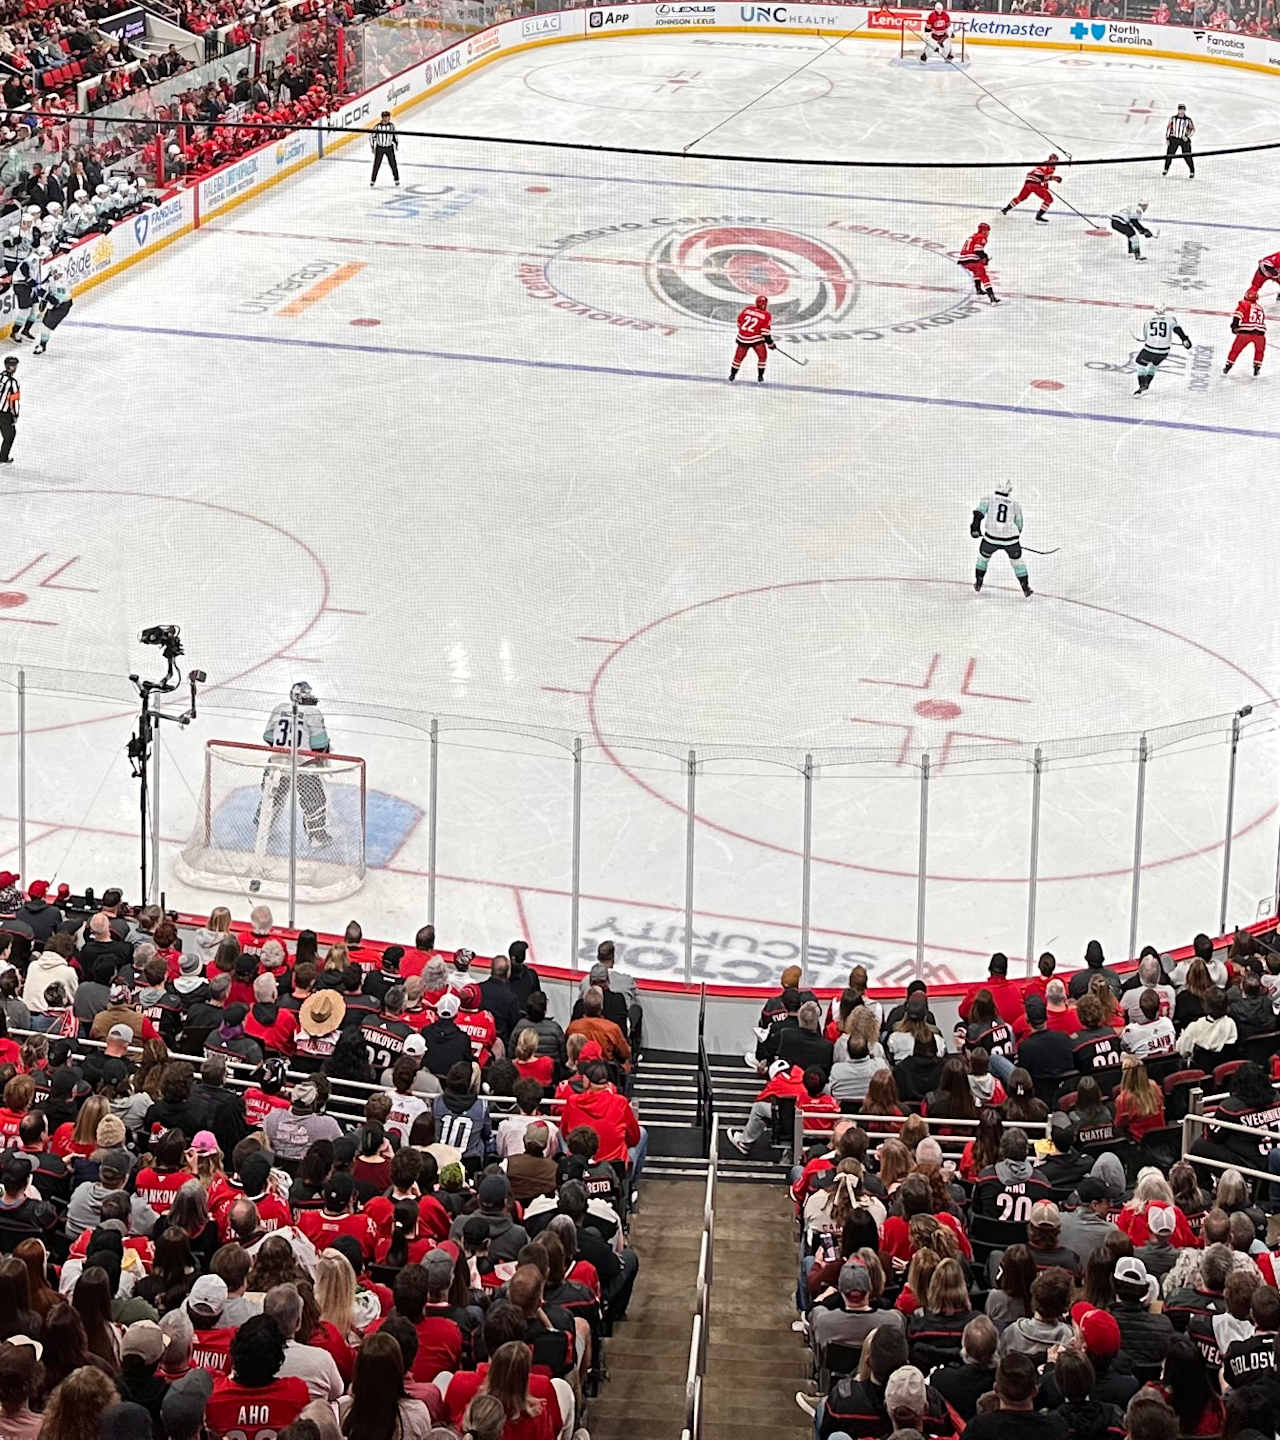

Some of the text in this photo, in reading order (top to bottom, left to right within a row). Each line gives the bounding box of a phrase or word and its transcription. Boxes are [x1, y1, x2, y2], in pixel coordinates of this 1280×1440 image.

[671, 5, 715, 13] LEXUS
[740, 7, 835, 24] UNC HEALTH
[872, 15, 918, 27] Lenovo
[1108, 24, 1139, 35] North
[1108, 34, 1153, 46] Carolina
[1208, 34, 1245, 49] Fanatics
[433, 51, 461, 80] MILNER
[1248, 309, 1264, 323] 53
[741, 316, 758, 332] 22
[1150, 322, 1167, 337] 59
[997, 504, 1008, 523] 8
[275, 717, 304, 748] 35
[586, 916, 880, 970] SECURITY
[993, 1029, 1007, 1042] AHO
[1096, 1041, 1111, 1053] AHO
[441, 1114, 472, 1152] 10
[237, 1406, 270, 1425] AHO
